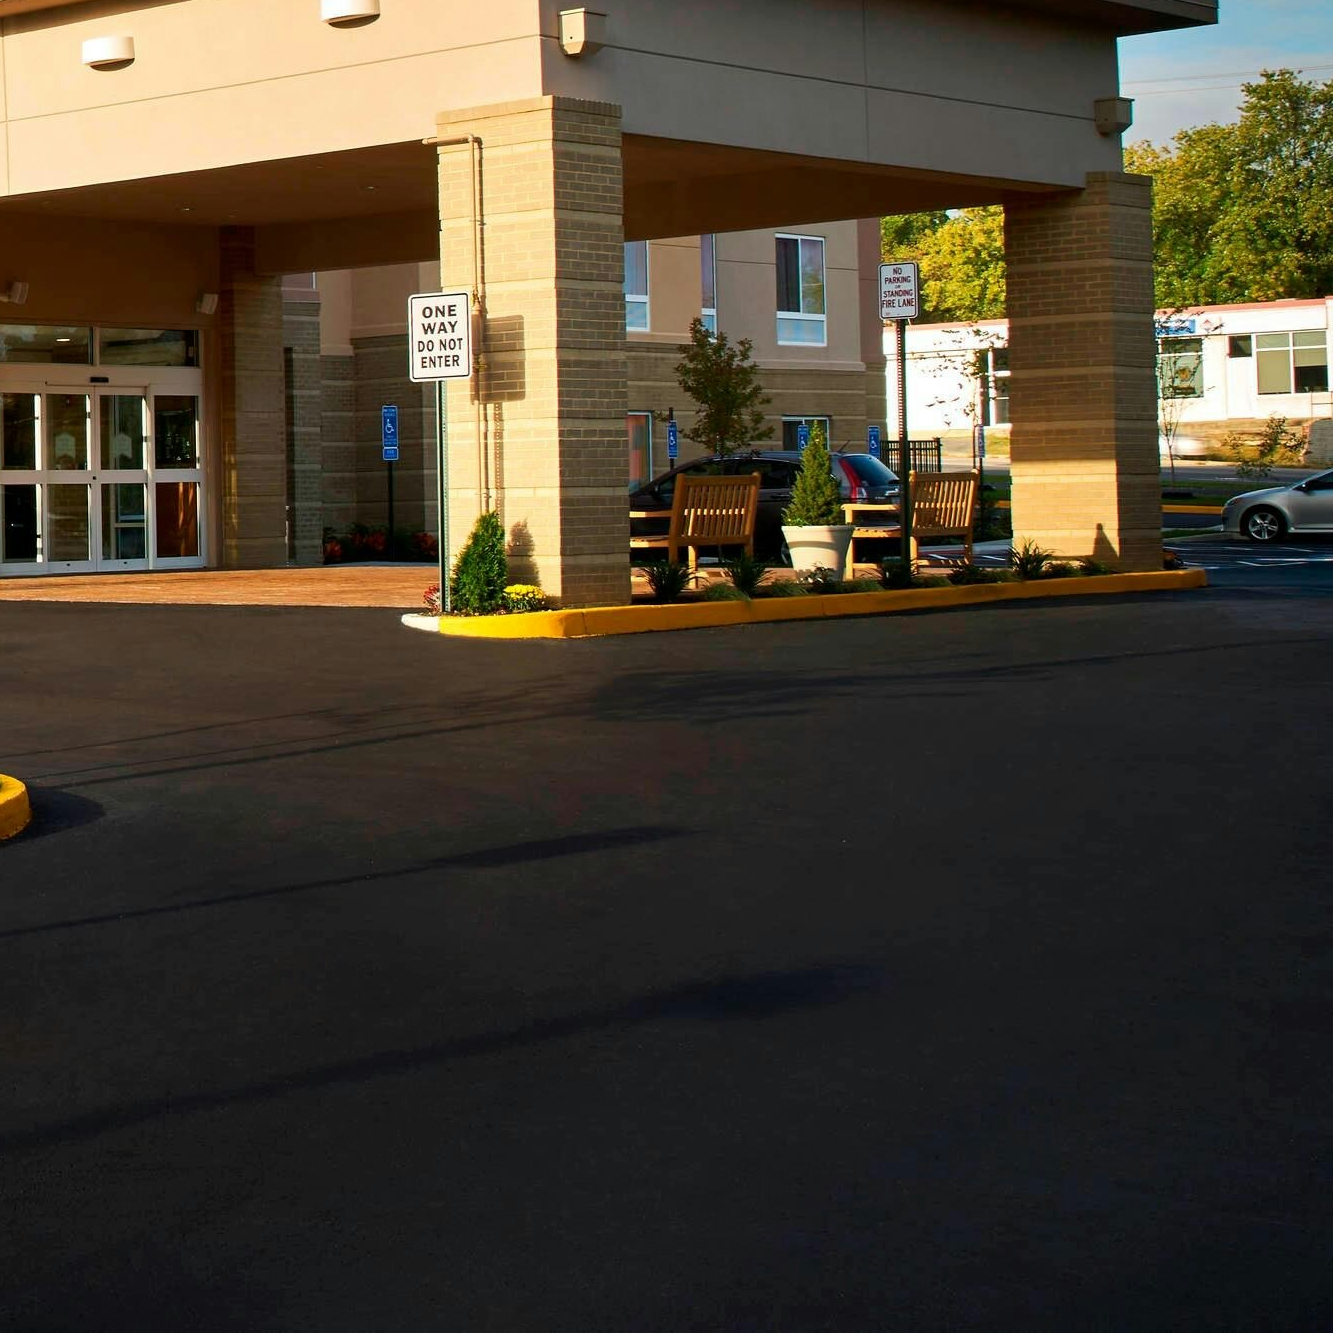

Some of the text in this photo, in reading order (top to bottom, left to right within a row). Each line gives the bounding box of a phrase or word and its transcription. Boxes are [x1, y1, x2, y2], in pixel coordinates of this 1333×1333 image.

[893, 267, 902, 275] NO
[884, 276, 911, 285] PARKING
[883, 289, 913, 298] STANDING
[882, 298, 915, 308] FIRE LANE
[422, 305, 457, 318] ONE
[421, 321, 458, 335] WAY
[417, 338, 463, 352] DO NOT
[421, 355, 460, 368] ENTER
